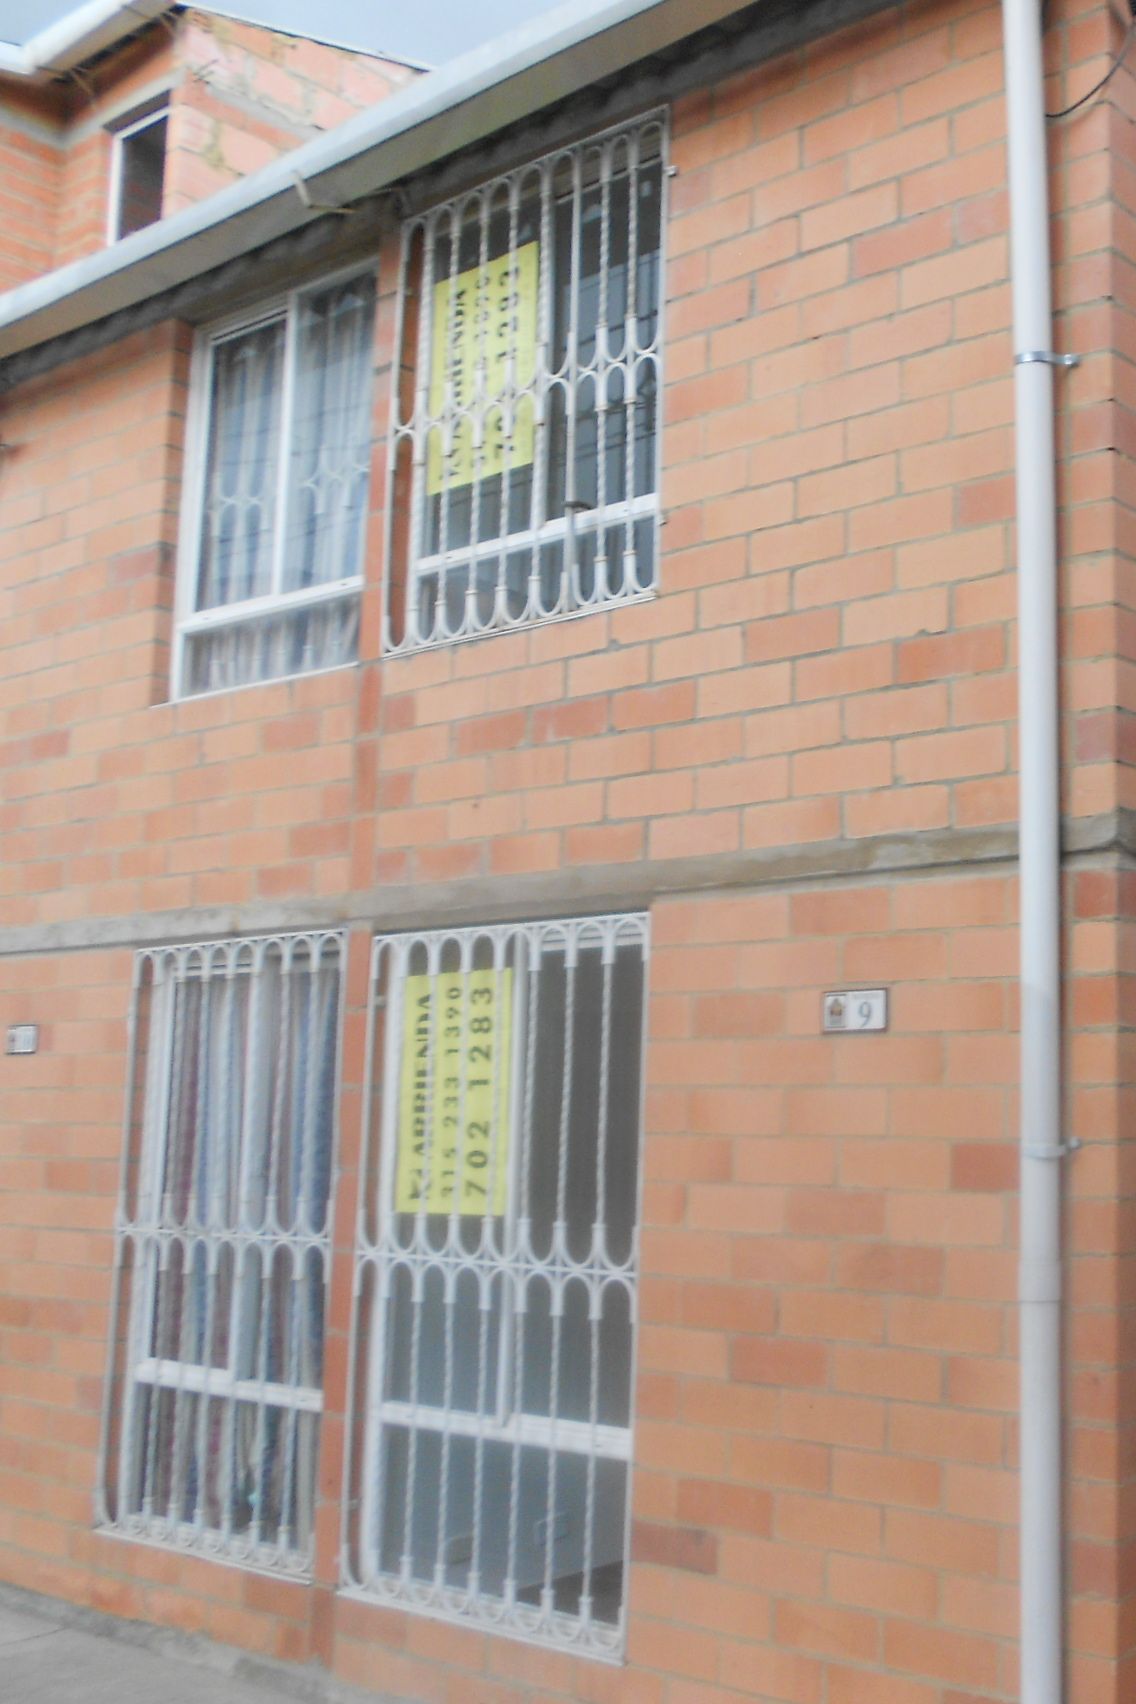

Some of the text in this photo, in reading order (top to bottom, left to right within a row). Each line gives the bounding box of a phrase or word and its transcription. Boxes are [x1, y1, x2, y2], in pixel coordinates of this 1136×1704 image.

[858, 1001, 872, 1028] 9
[465, 986, 493, 1198] 702 1283
